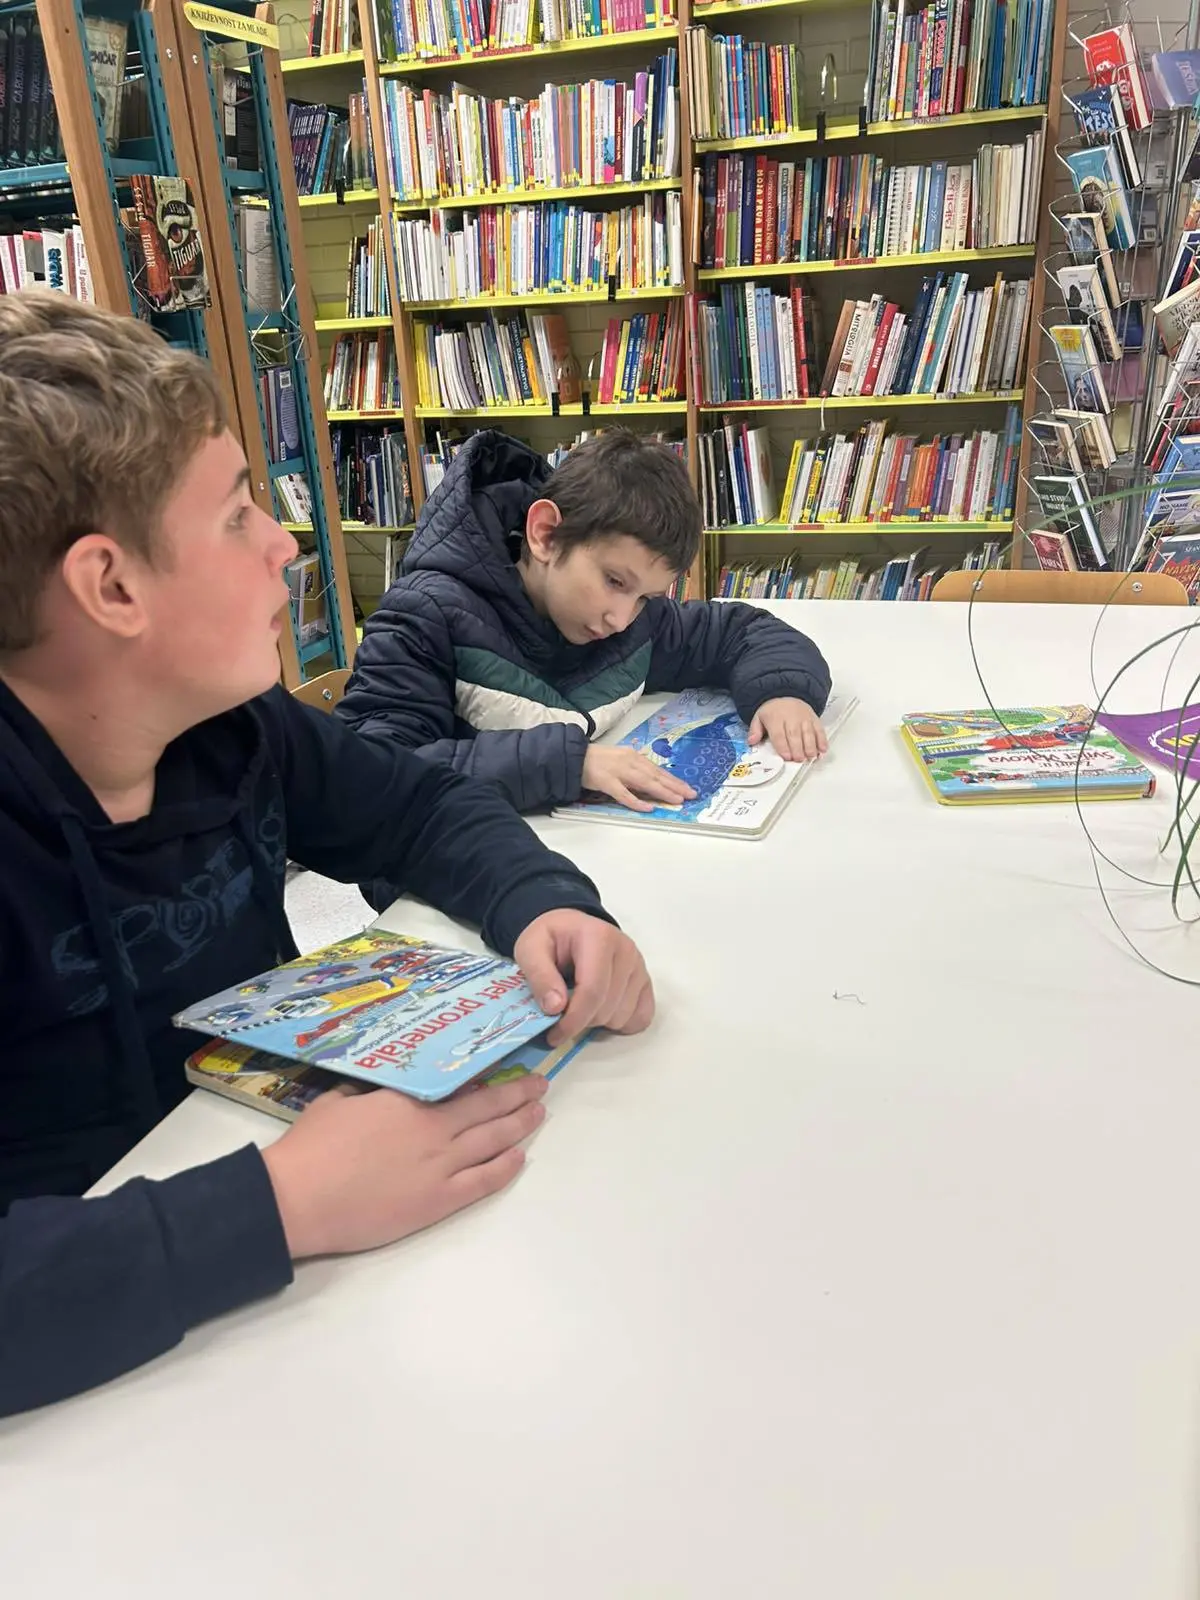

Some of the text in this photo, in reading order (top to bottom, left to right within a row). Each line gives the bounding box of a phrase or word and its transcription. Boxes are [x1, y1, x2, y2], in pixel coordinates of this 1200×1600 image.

[754, 169, 764, 265] MOJA PRVA BIBLIJA
[47, 247, 64, 289] VADIS
[141, 234, 156, 268] TIGUAR
[747, 291, 757, 349] MITOLOGIJA
[844, 313, 862, 356] MITOLOGIJA
[354, 997, 486, 1070] prometala
